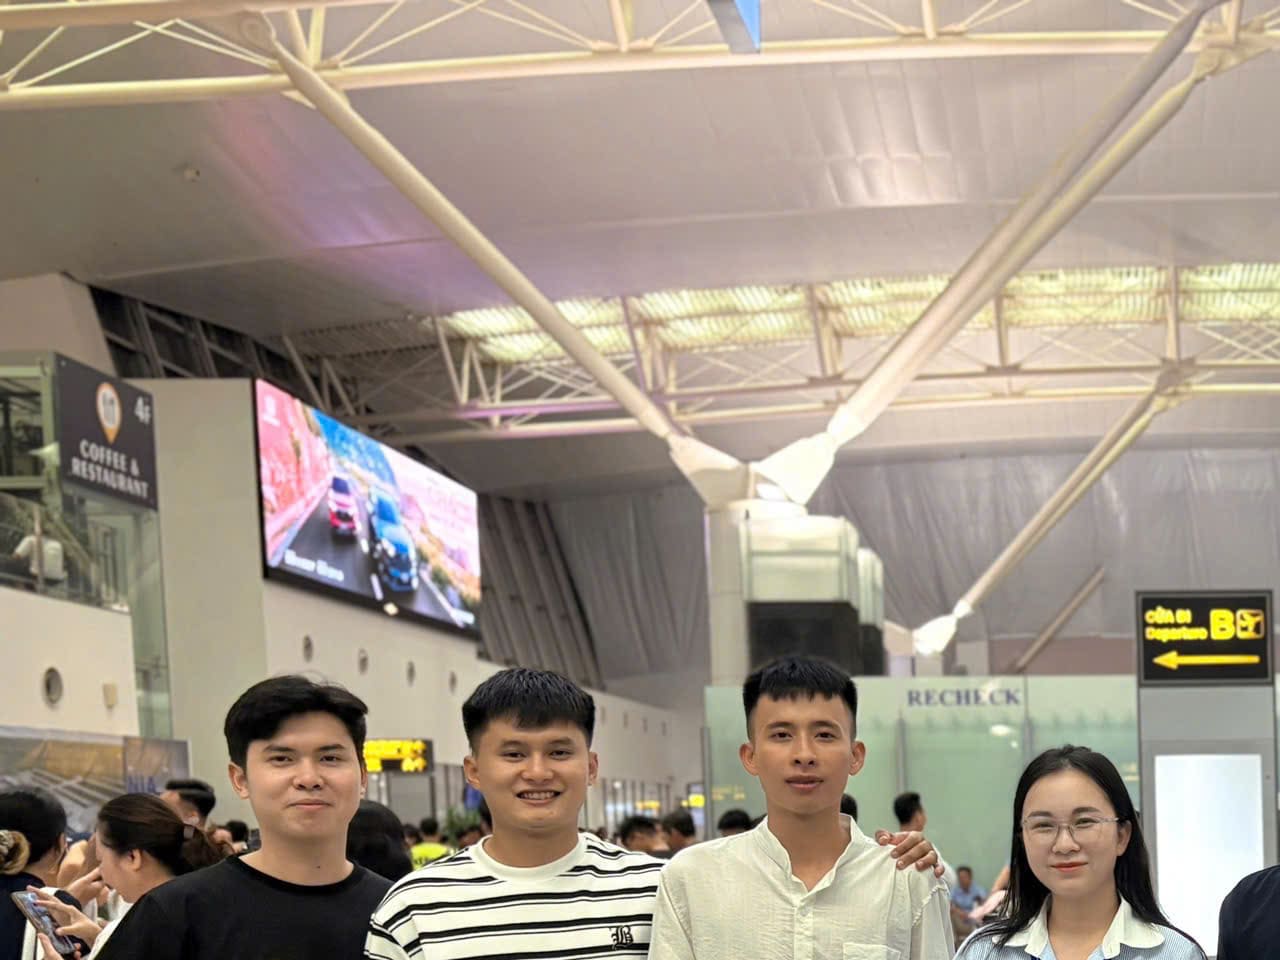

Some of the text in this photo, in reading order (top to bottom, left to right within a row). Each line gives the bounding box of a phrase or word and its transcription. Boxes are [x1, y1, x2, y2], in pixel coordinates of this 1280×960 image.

[79, 439, 127, 472] COFFEE
[71, 457, 149, 498] RESTAURANT
[1209, 609, 1236, 640] B
[907, 689, 1021, 707] RECHECK
